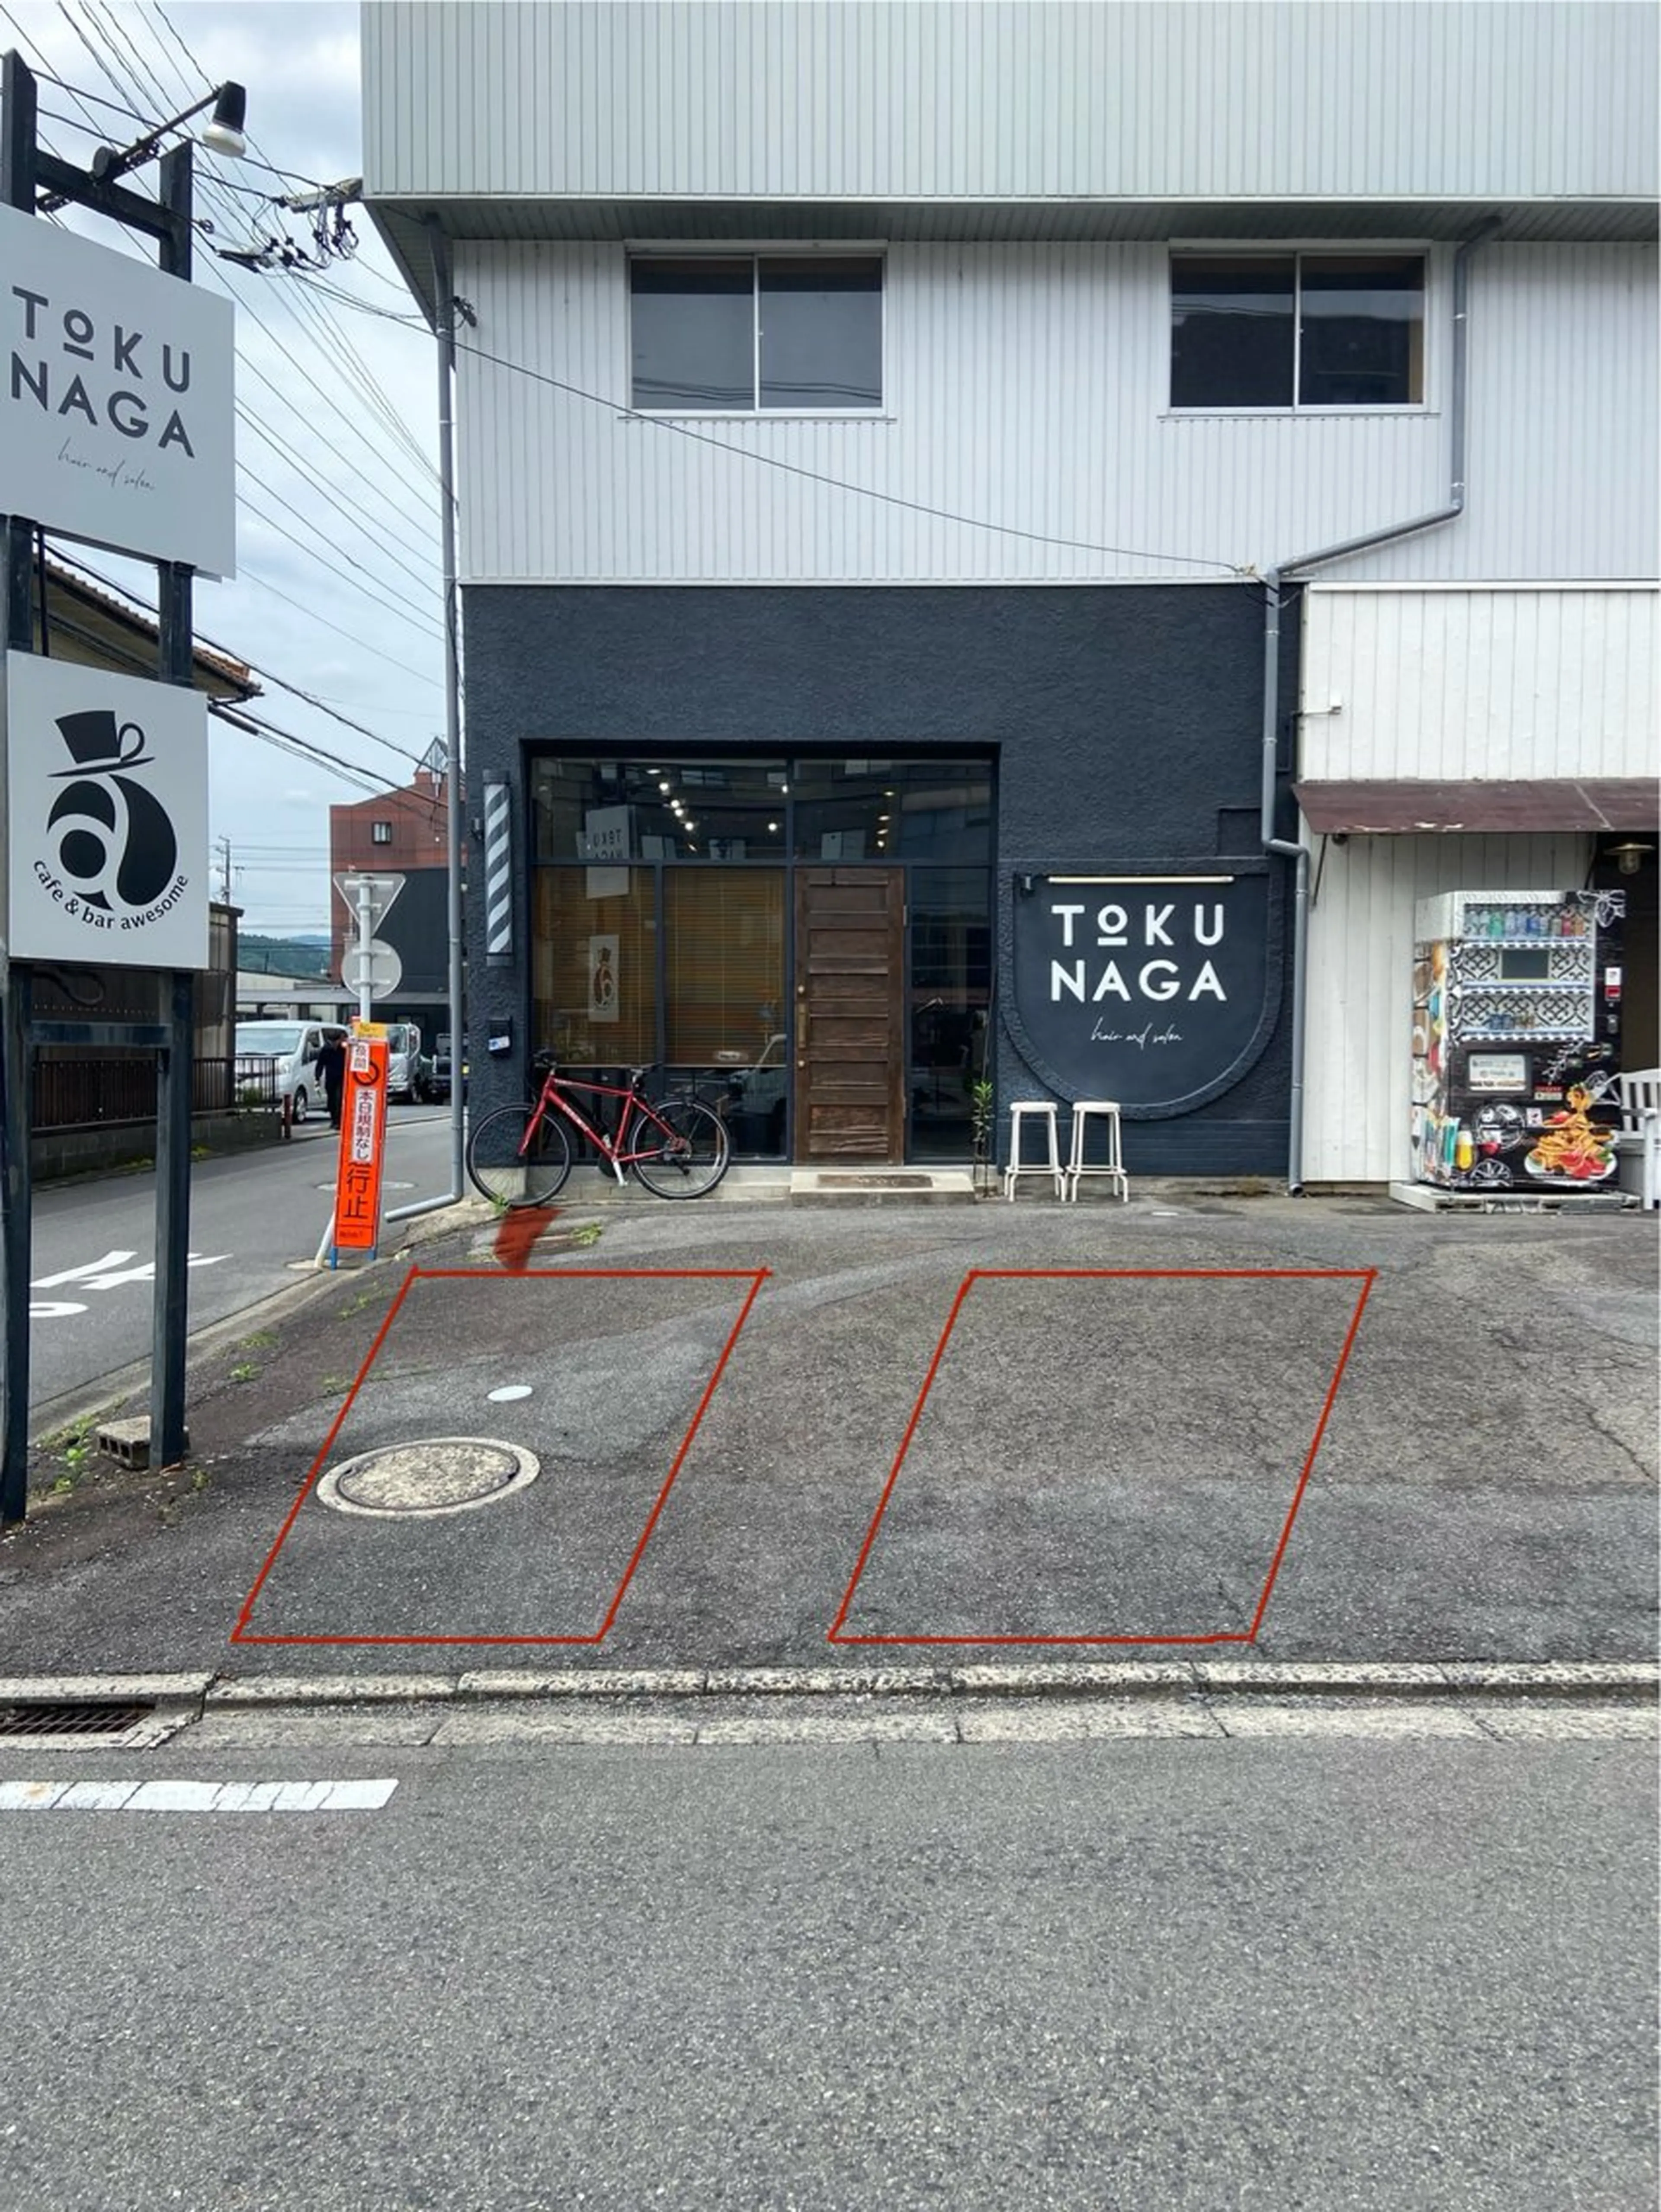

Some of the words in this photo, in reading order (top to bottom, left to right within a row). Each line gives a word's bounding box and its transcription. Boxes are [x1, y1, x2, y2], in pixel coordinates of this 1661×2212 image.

[12, 285, 190, 393] TOKU
[11, 351, 195, 458] NAGA
[34, 860, 63, 902] cafe
[64, 898, 79, 915] &
[82, 906, 115, 929] bar
[120, 875, 189, 930] awesome
[1051, 904, 1224, 946] TOKU
[1051, 959, 1227, 1002] NAGA
[1090, 1016, 1122, 1041] hair
[1126, 1022, 1153, 1050] and
[356, 1090, 373, 1160] 本日規制なし
[343, 1162, 372, 1219] 行止
